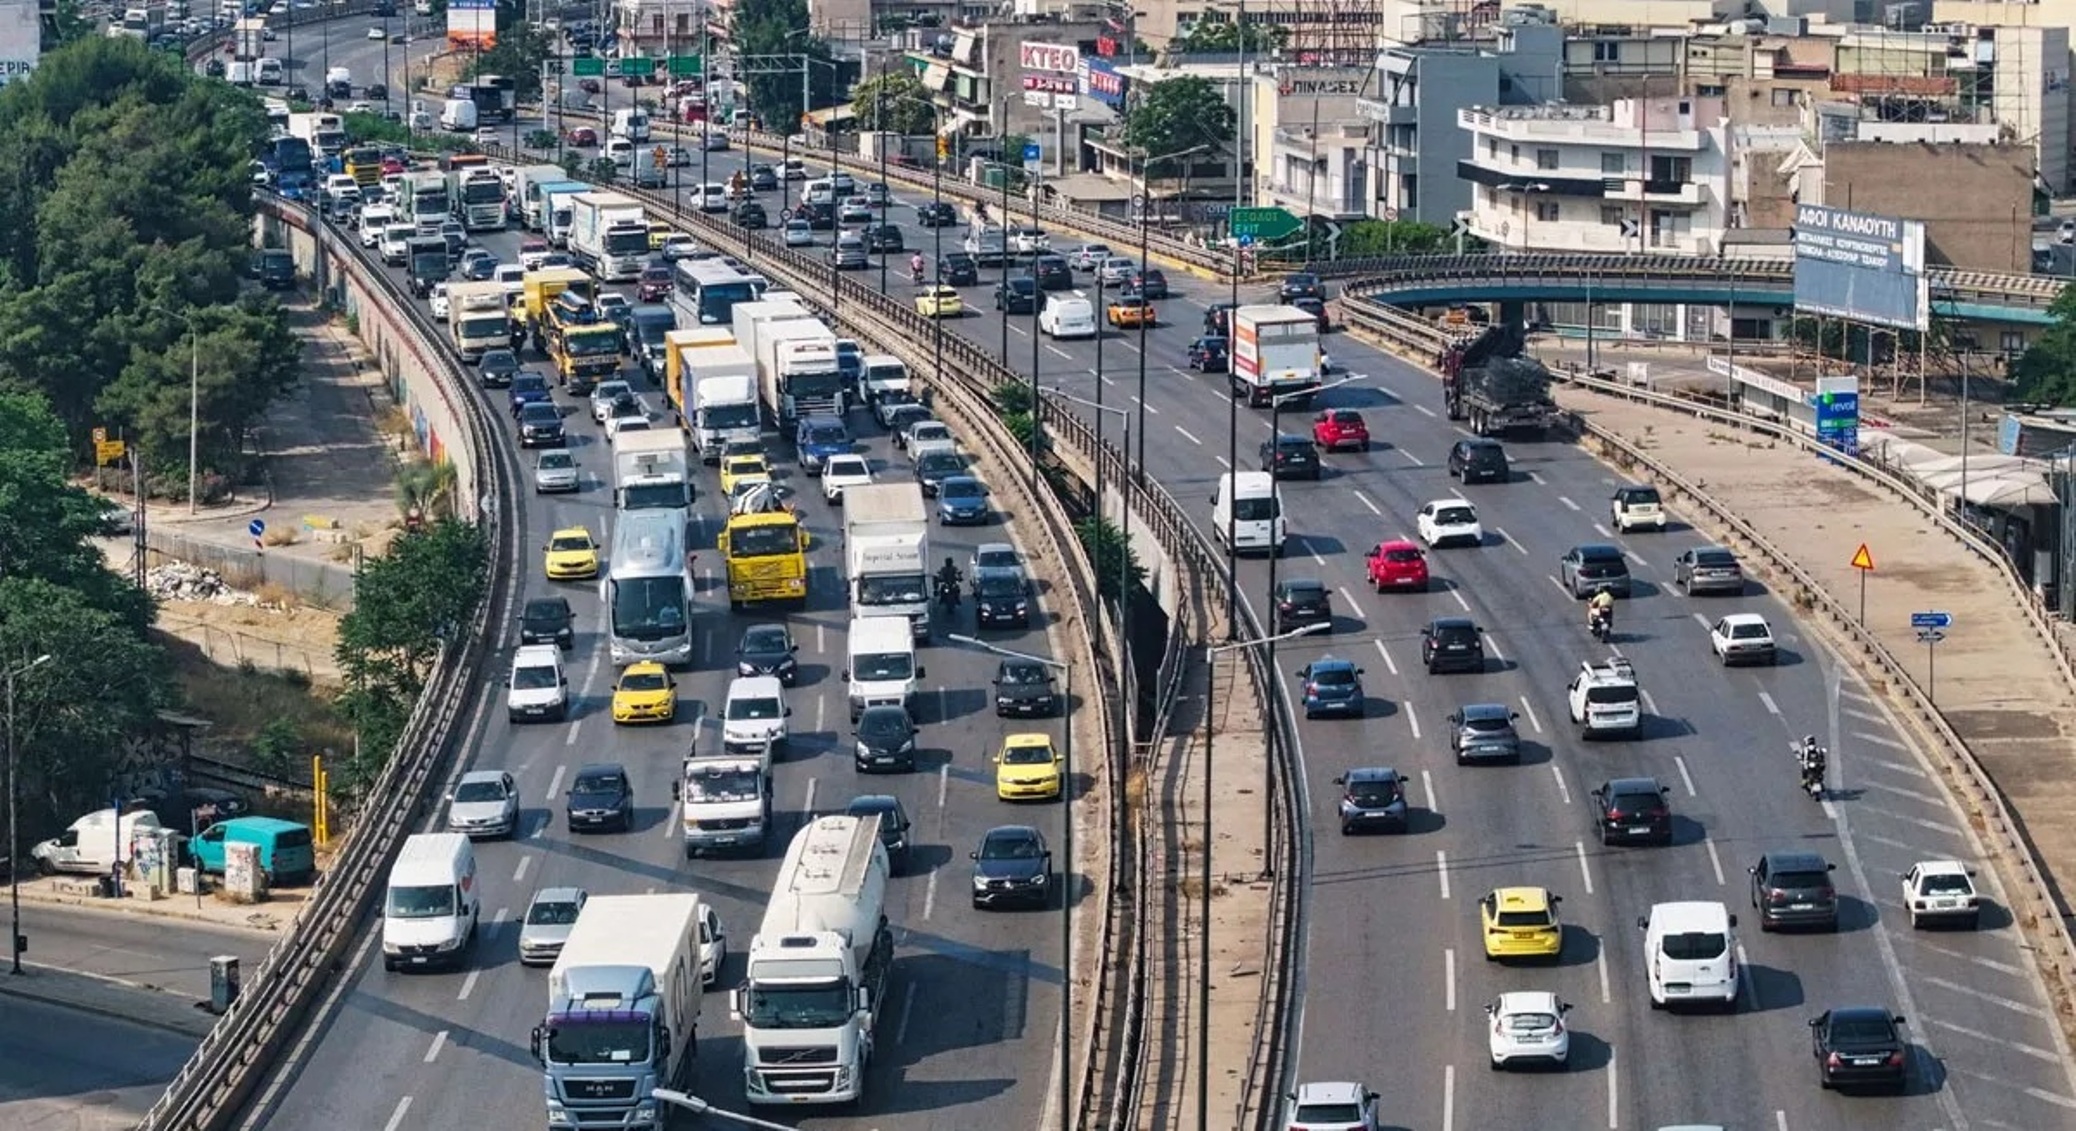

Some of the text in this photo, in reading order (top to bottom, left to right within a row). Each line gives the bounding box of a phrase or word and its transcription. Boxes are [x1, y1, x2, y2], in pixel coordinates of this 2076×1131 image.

[1023, 45, 1075, 70] ΚΤΕΟ
[1234, 223, 1260, 235] EXIT
[1799, 207, 1897, 239] ΑΦΟΙ ΚΑΝΑΟΥΤΗ
[1830, 400, 1856, 413] revoil
